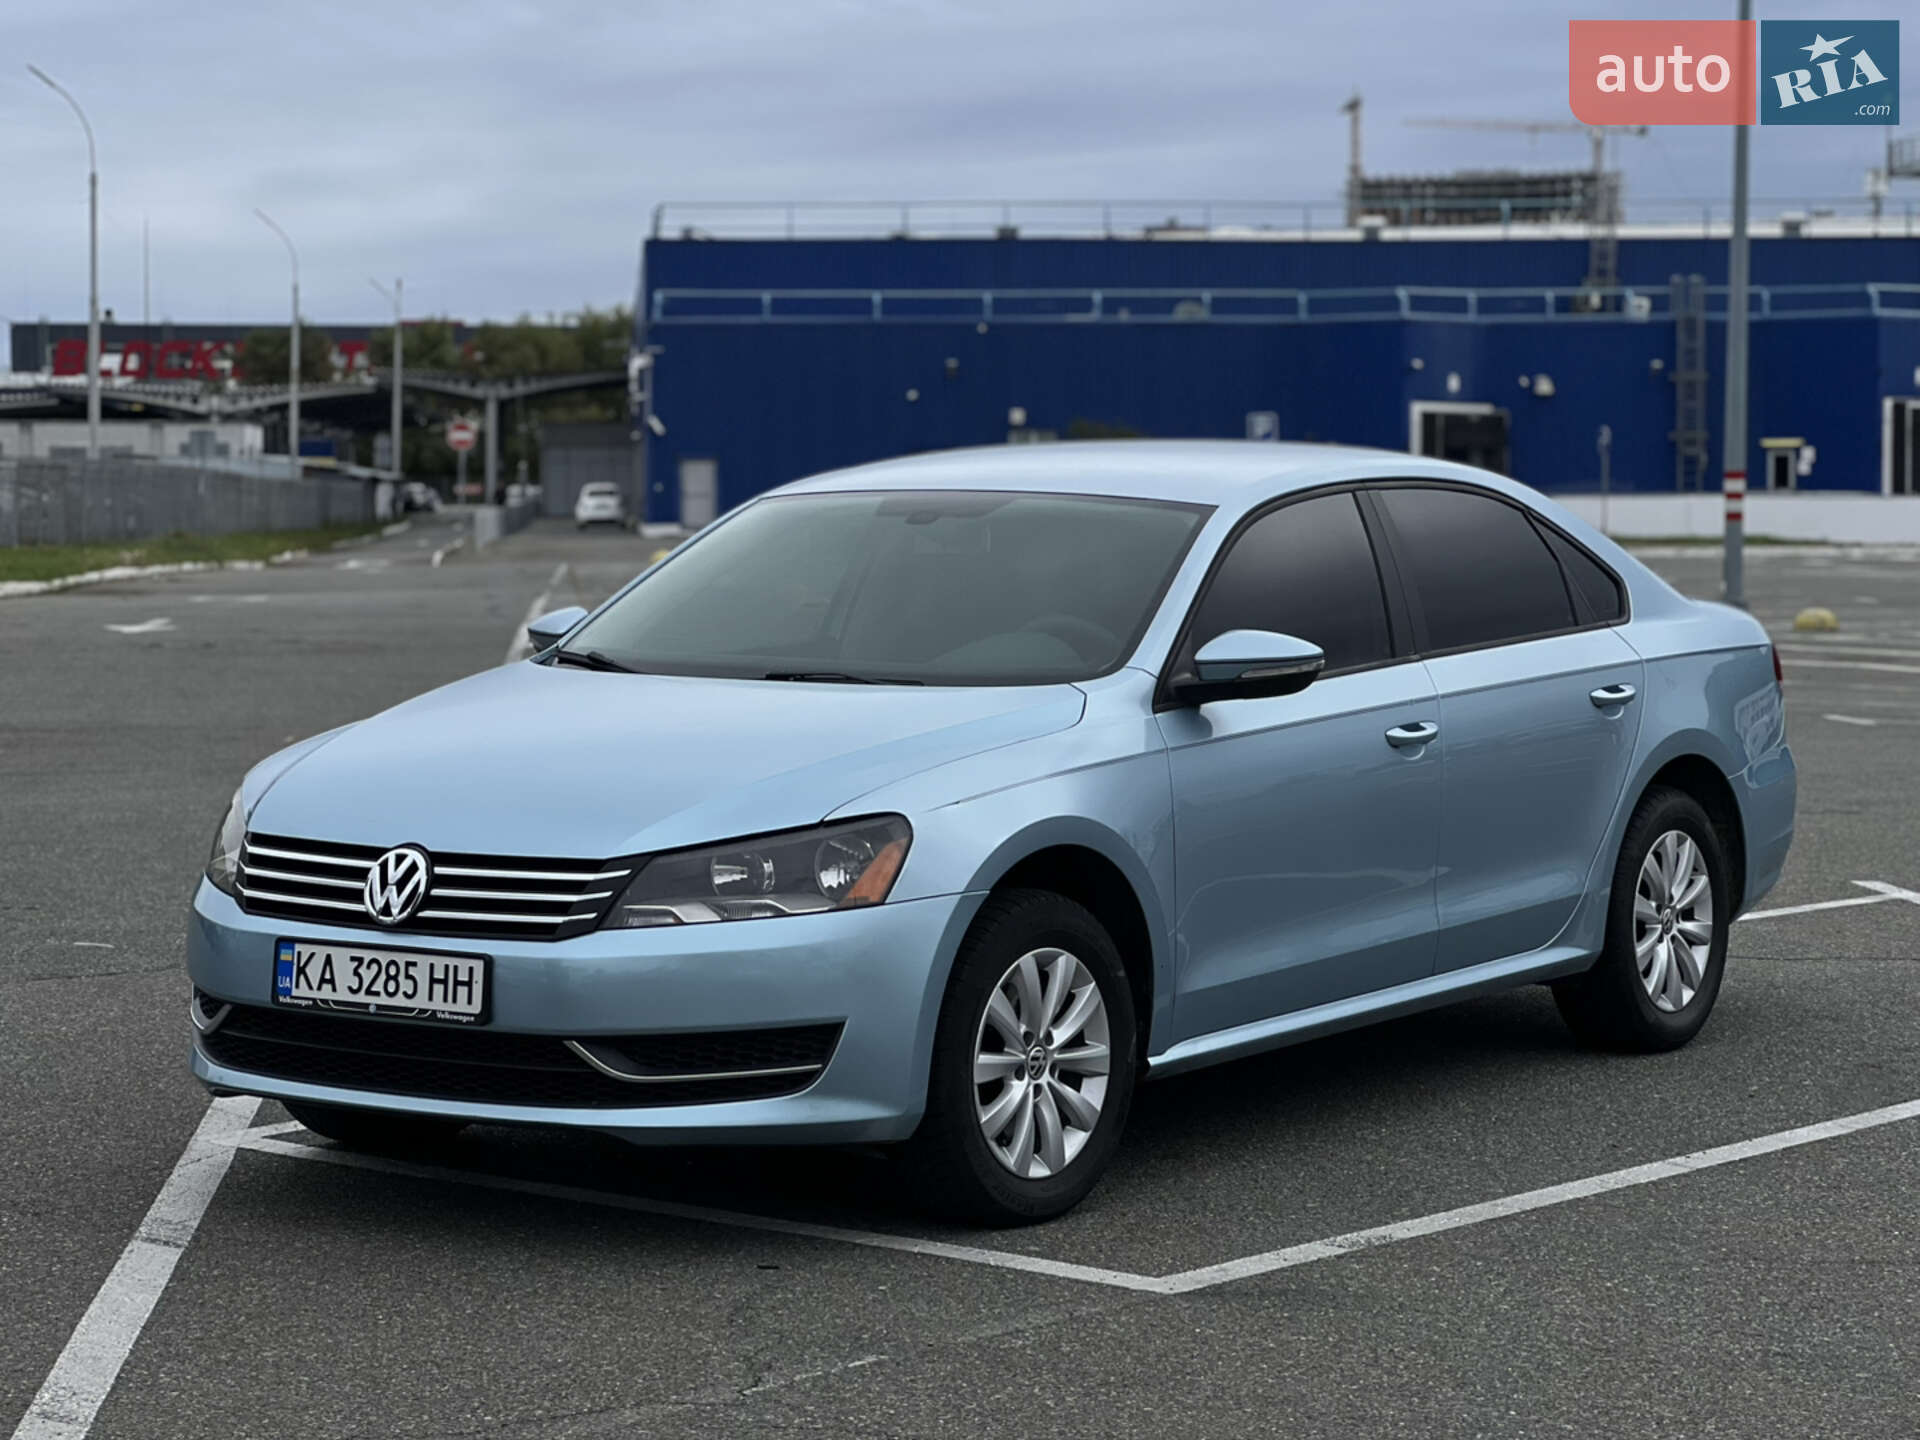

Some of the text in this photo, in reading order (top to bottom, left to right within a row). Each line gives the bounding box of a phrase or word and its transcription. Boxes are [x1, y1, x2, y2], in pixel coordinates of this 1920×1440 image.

[278, 975, 292, 988] UA
[295, 950, 474, 1005] KA 3285 HH
